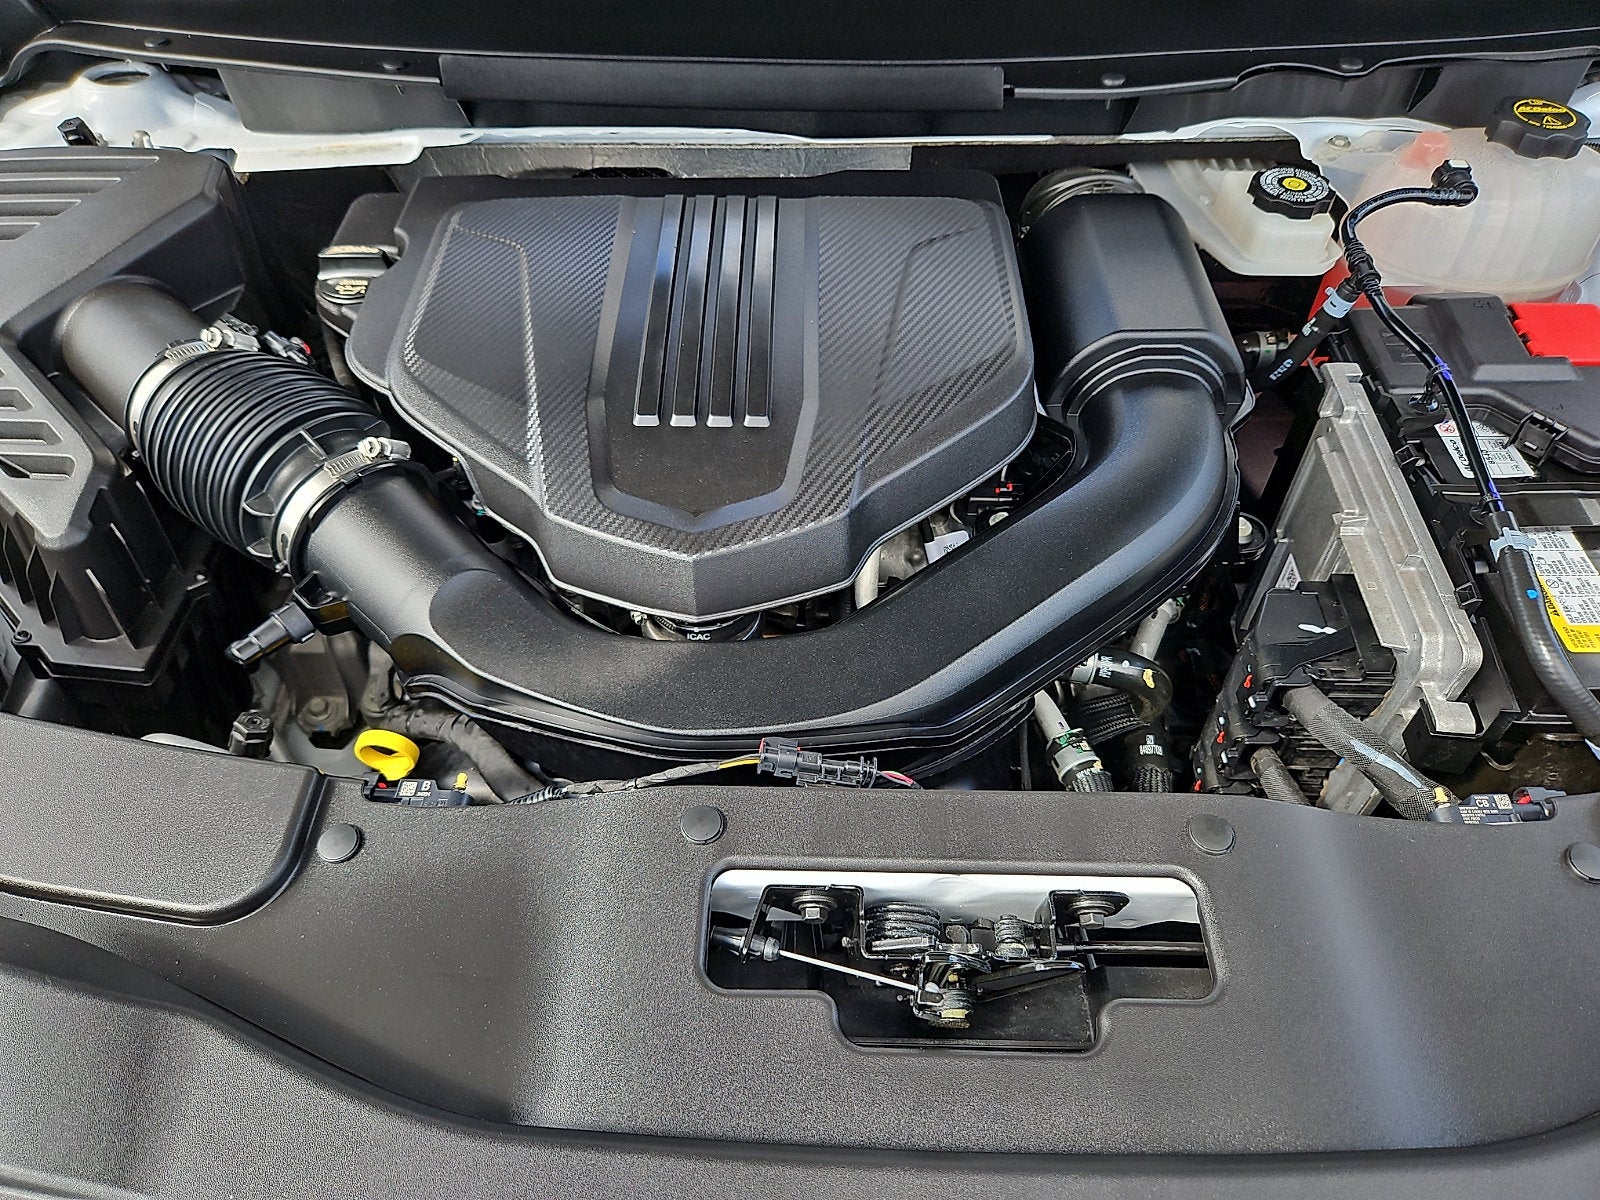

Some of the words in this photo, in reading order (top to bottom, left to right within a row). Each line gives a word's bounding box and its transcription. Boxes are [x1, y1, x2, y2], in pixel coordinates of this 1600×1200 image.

[686, 632, 712, 641] ICAC
[421, 781, 431, 791] B
[1475, 799, 1490, 808] CB
